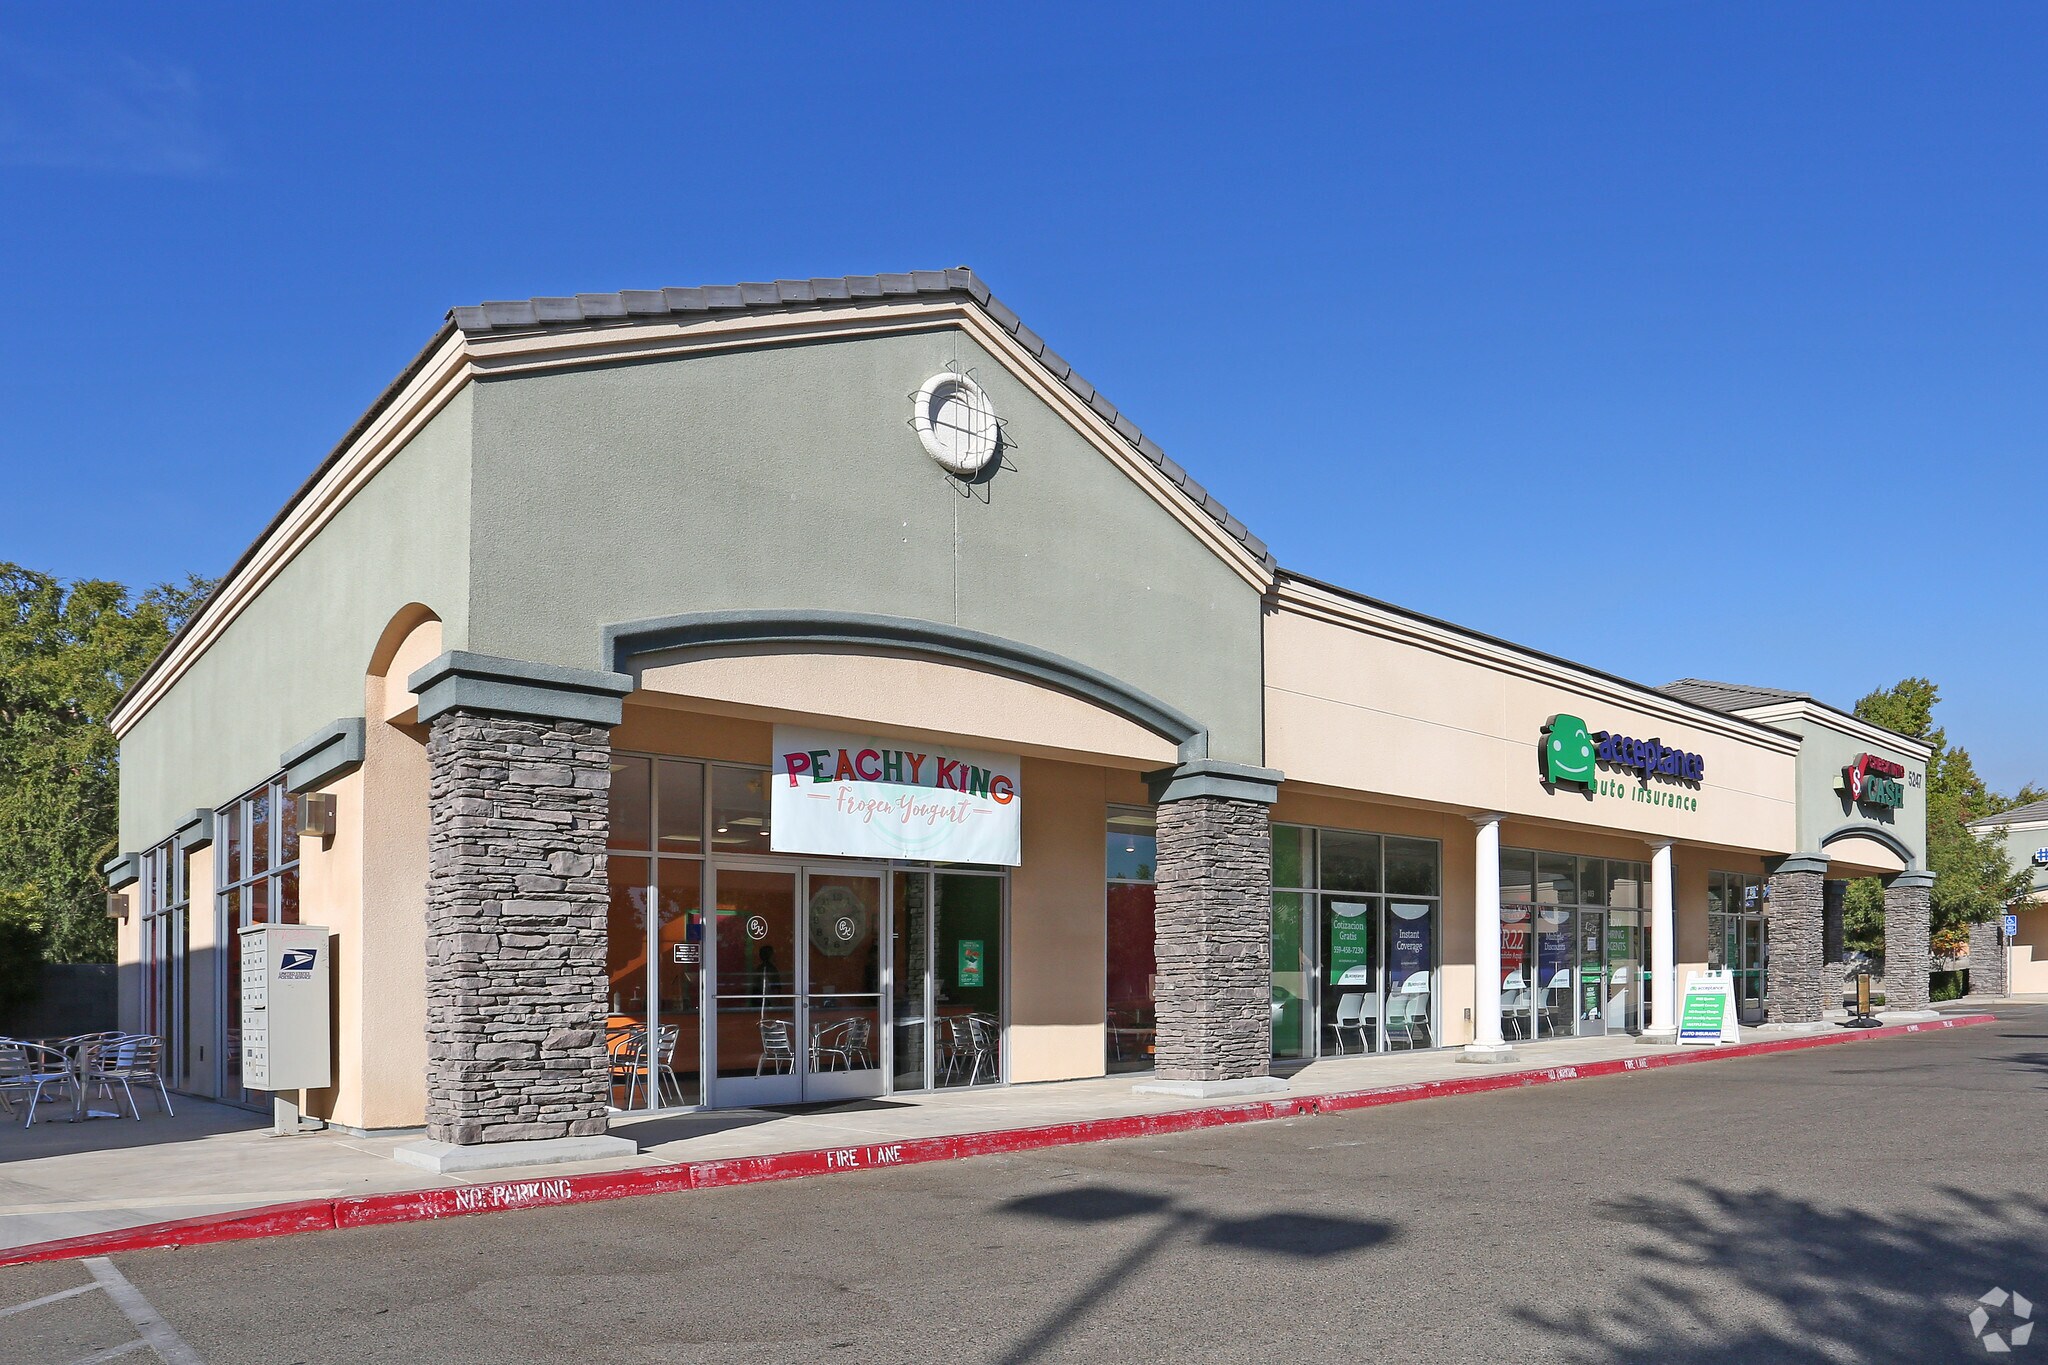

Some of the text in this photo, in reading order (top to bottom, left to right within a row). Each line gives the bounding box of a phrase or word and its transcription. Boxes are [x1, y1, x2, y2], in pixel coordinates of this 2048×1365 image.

[1598, 730, 1704, 781] acceptance
[783, 748, 1014, 805] PEACHY KING
[1908, 770, 1922, 788] 5247
[836, 785, 895, 823] Frozen
[1593, 779, 1698, 812] auto insurance
[1866, 774, 1904, 809] CASH
[1339, 931, 1358, 941] Gratis
[1396, 940, 1423, 953] Coverage
[1399, 928, 1420, 939] Instant
[1501, 928, 1524, 950] R22
[826, 1145, 903, 1168] FIRE LANE
[455, 1188, 483, 1210] NO
[491, 1179, 572, 1207] PARKING
